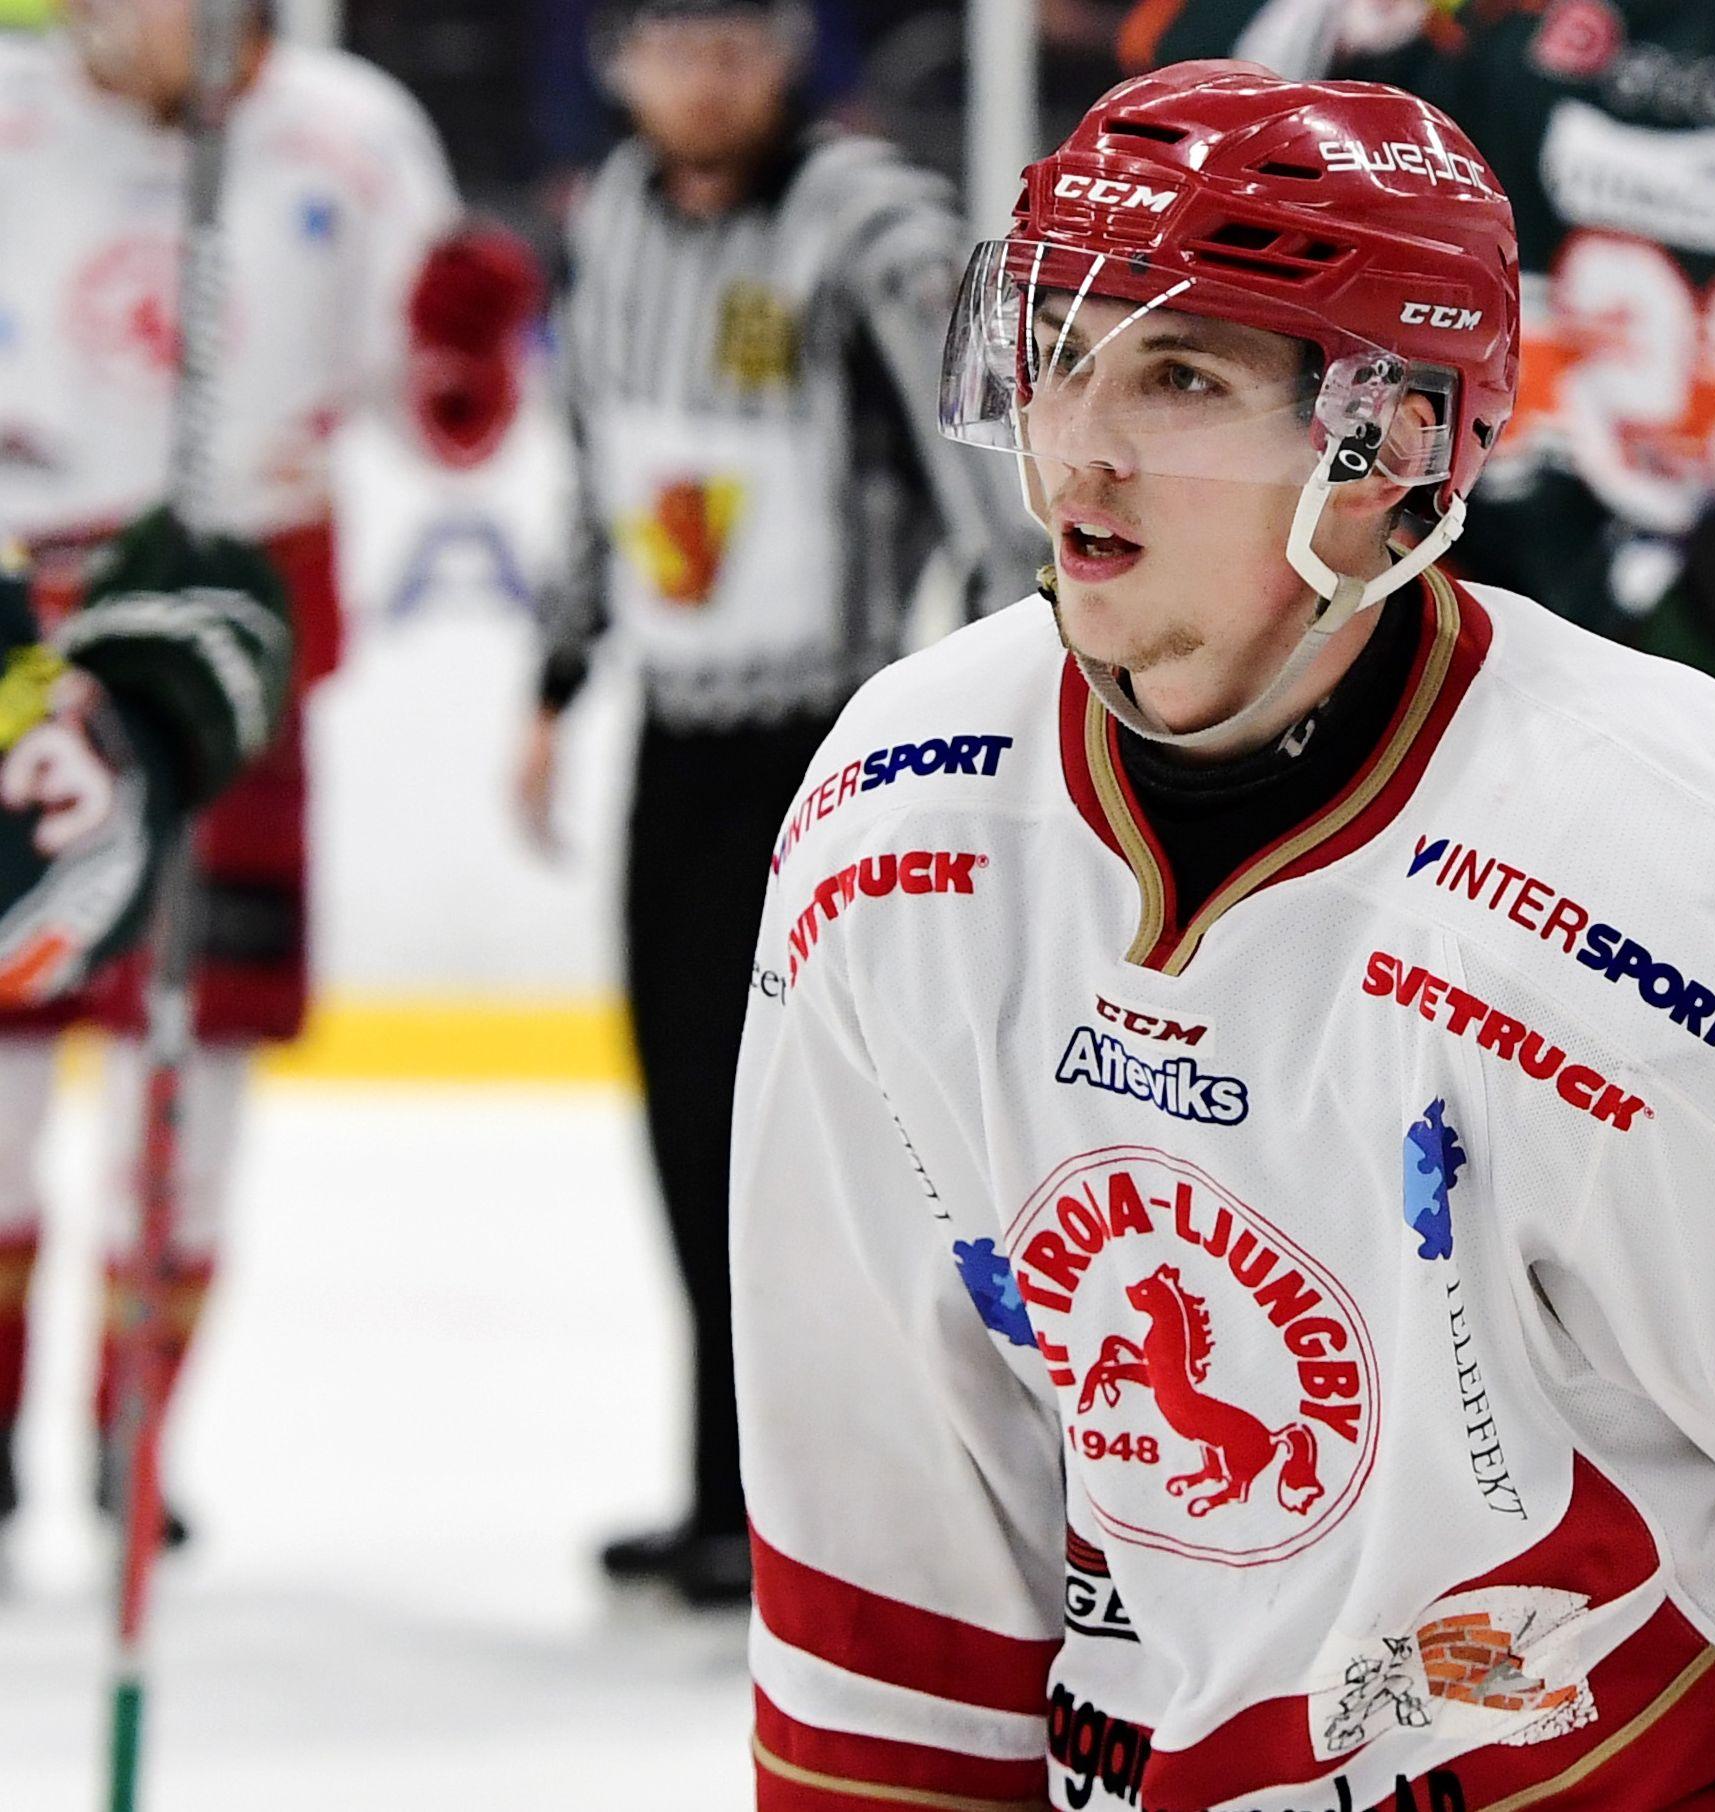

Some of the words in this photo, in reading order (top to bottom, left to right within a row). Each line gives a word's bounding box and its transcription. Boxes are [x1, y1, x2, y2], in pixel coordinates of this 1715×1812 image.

[1053, 173, 1178, 214] CCM
[1400, 301, 1483, 331] CCM
[1095, 994, 1208, 1047] CCM
[1055, 1026, 1249, 1126] Atteviks
[1068, 1425, 1160, 1465] 1948
